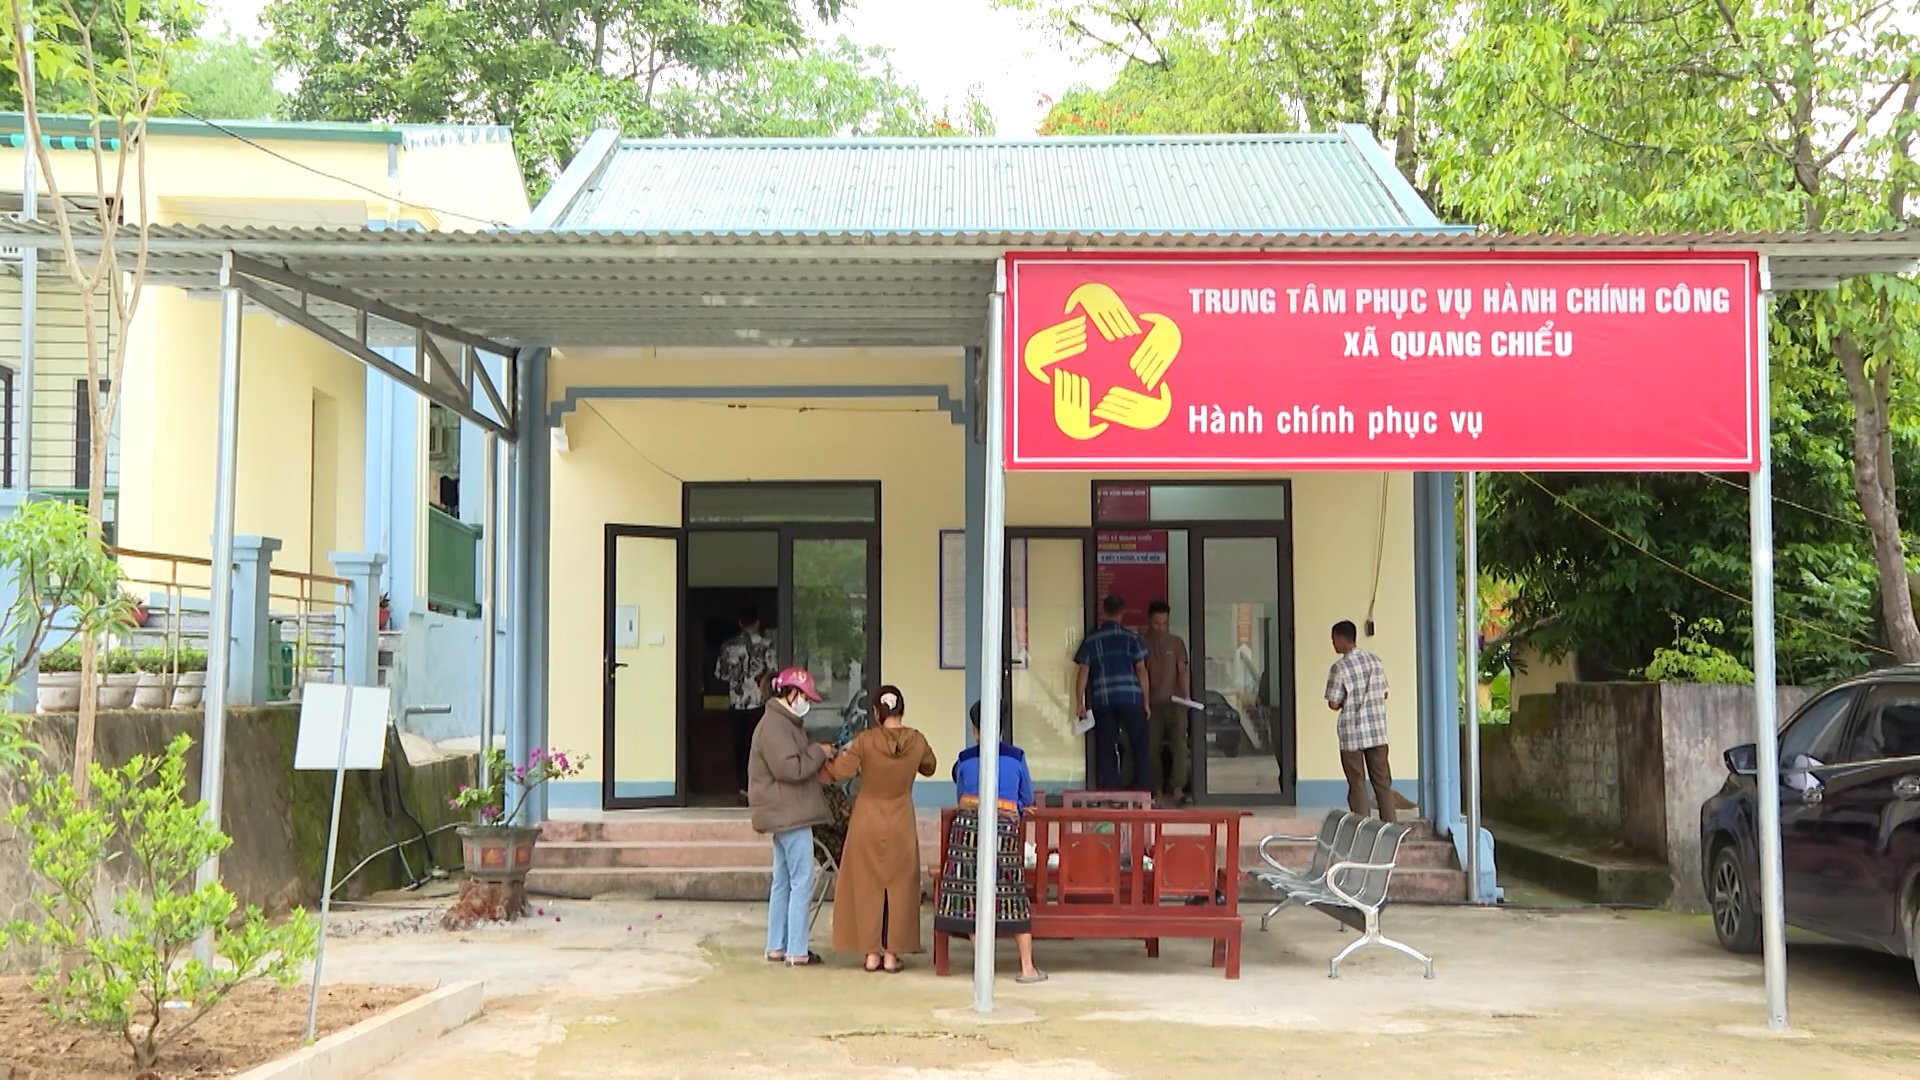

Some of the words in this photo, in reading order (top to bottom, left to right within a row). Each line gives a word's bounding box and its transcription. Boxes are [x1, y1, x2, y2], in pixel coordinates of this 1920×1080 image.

[1188, 287, 1276, 314] TRUNG
[1286, 283, 1346, 314] TÂM
[1356, 288, 1428, 320] PHỤC
[1437, 288, 1472, 320] VỤ
[1483, 282, 1557, 314] HÀNH
[1566, 283, 1646, 314] CHÍNH
[1655, 283, 1730, 314] CÔNG
[1343, 326, 1380, 357] XÃ
[1390, 331, 1482, 360] QUANG
[1491, 320, 1573, 357] CHIỂU
[1188, 404, 1263, 434] Hành
[1277, 404, 1355, 434] chính
[1368, 405, 1438, 440] phục
[1450, 411, 1483, 439] vụ
